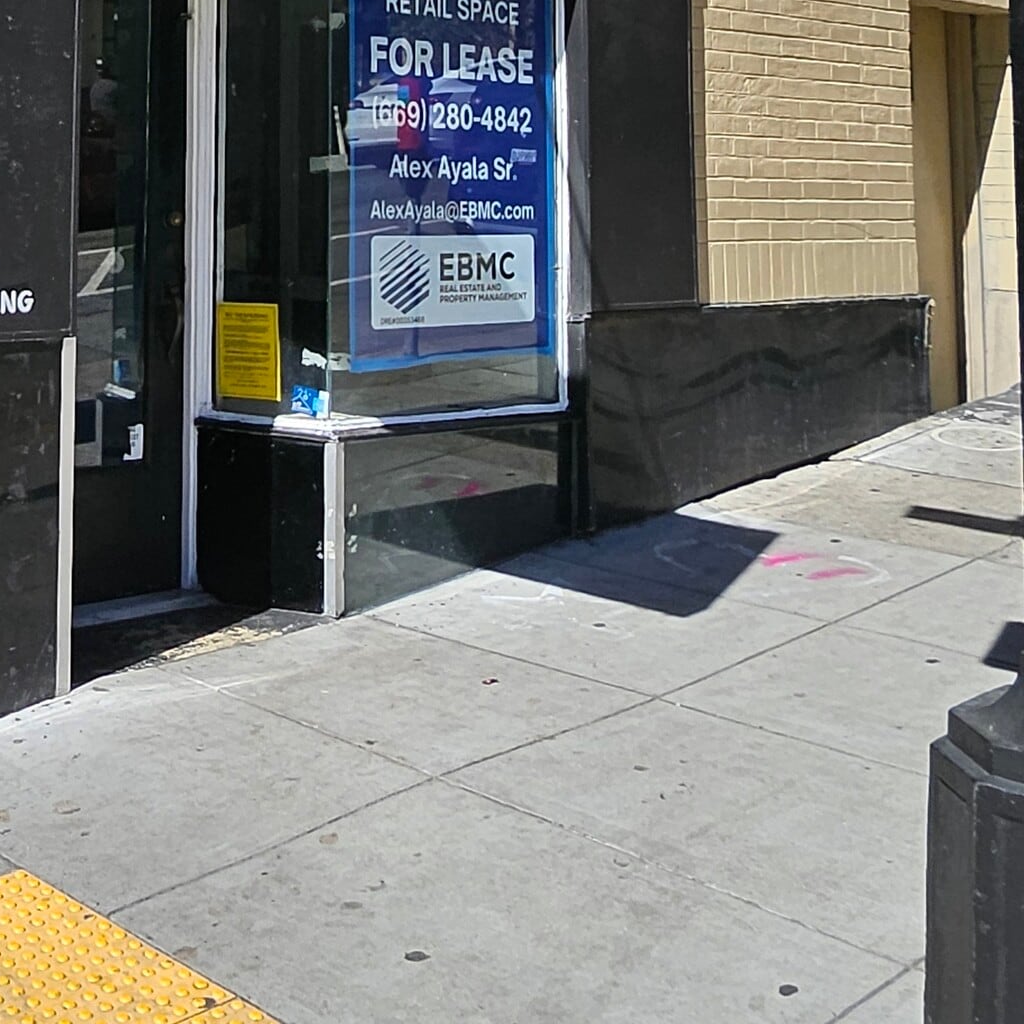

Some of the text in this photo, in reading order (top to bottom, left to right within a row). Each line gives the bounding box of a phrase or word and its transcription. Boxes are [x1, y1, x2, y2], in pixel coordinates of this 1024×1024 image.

[370, 36, 534, 84] FOR LEASE
[373, 96, 533, 133] (669) 280-4842
[389, 154, 432, 178] Alex
[438, 155, 489, 185] Ayala
[493, 158, 518, 181] Sr.
[370, 200, 534, 223] AlexAyala@EBMC.com
[440, 252, 515, 281] EBMC
[440, 283, 502, 293] REAL ESTATE AND
[440, 292, 527, 303] PROPERTY MANAGEMENT
